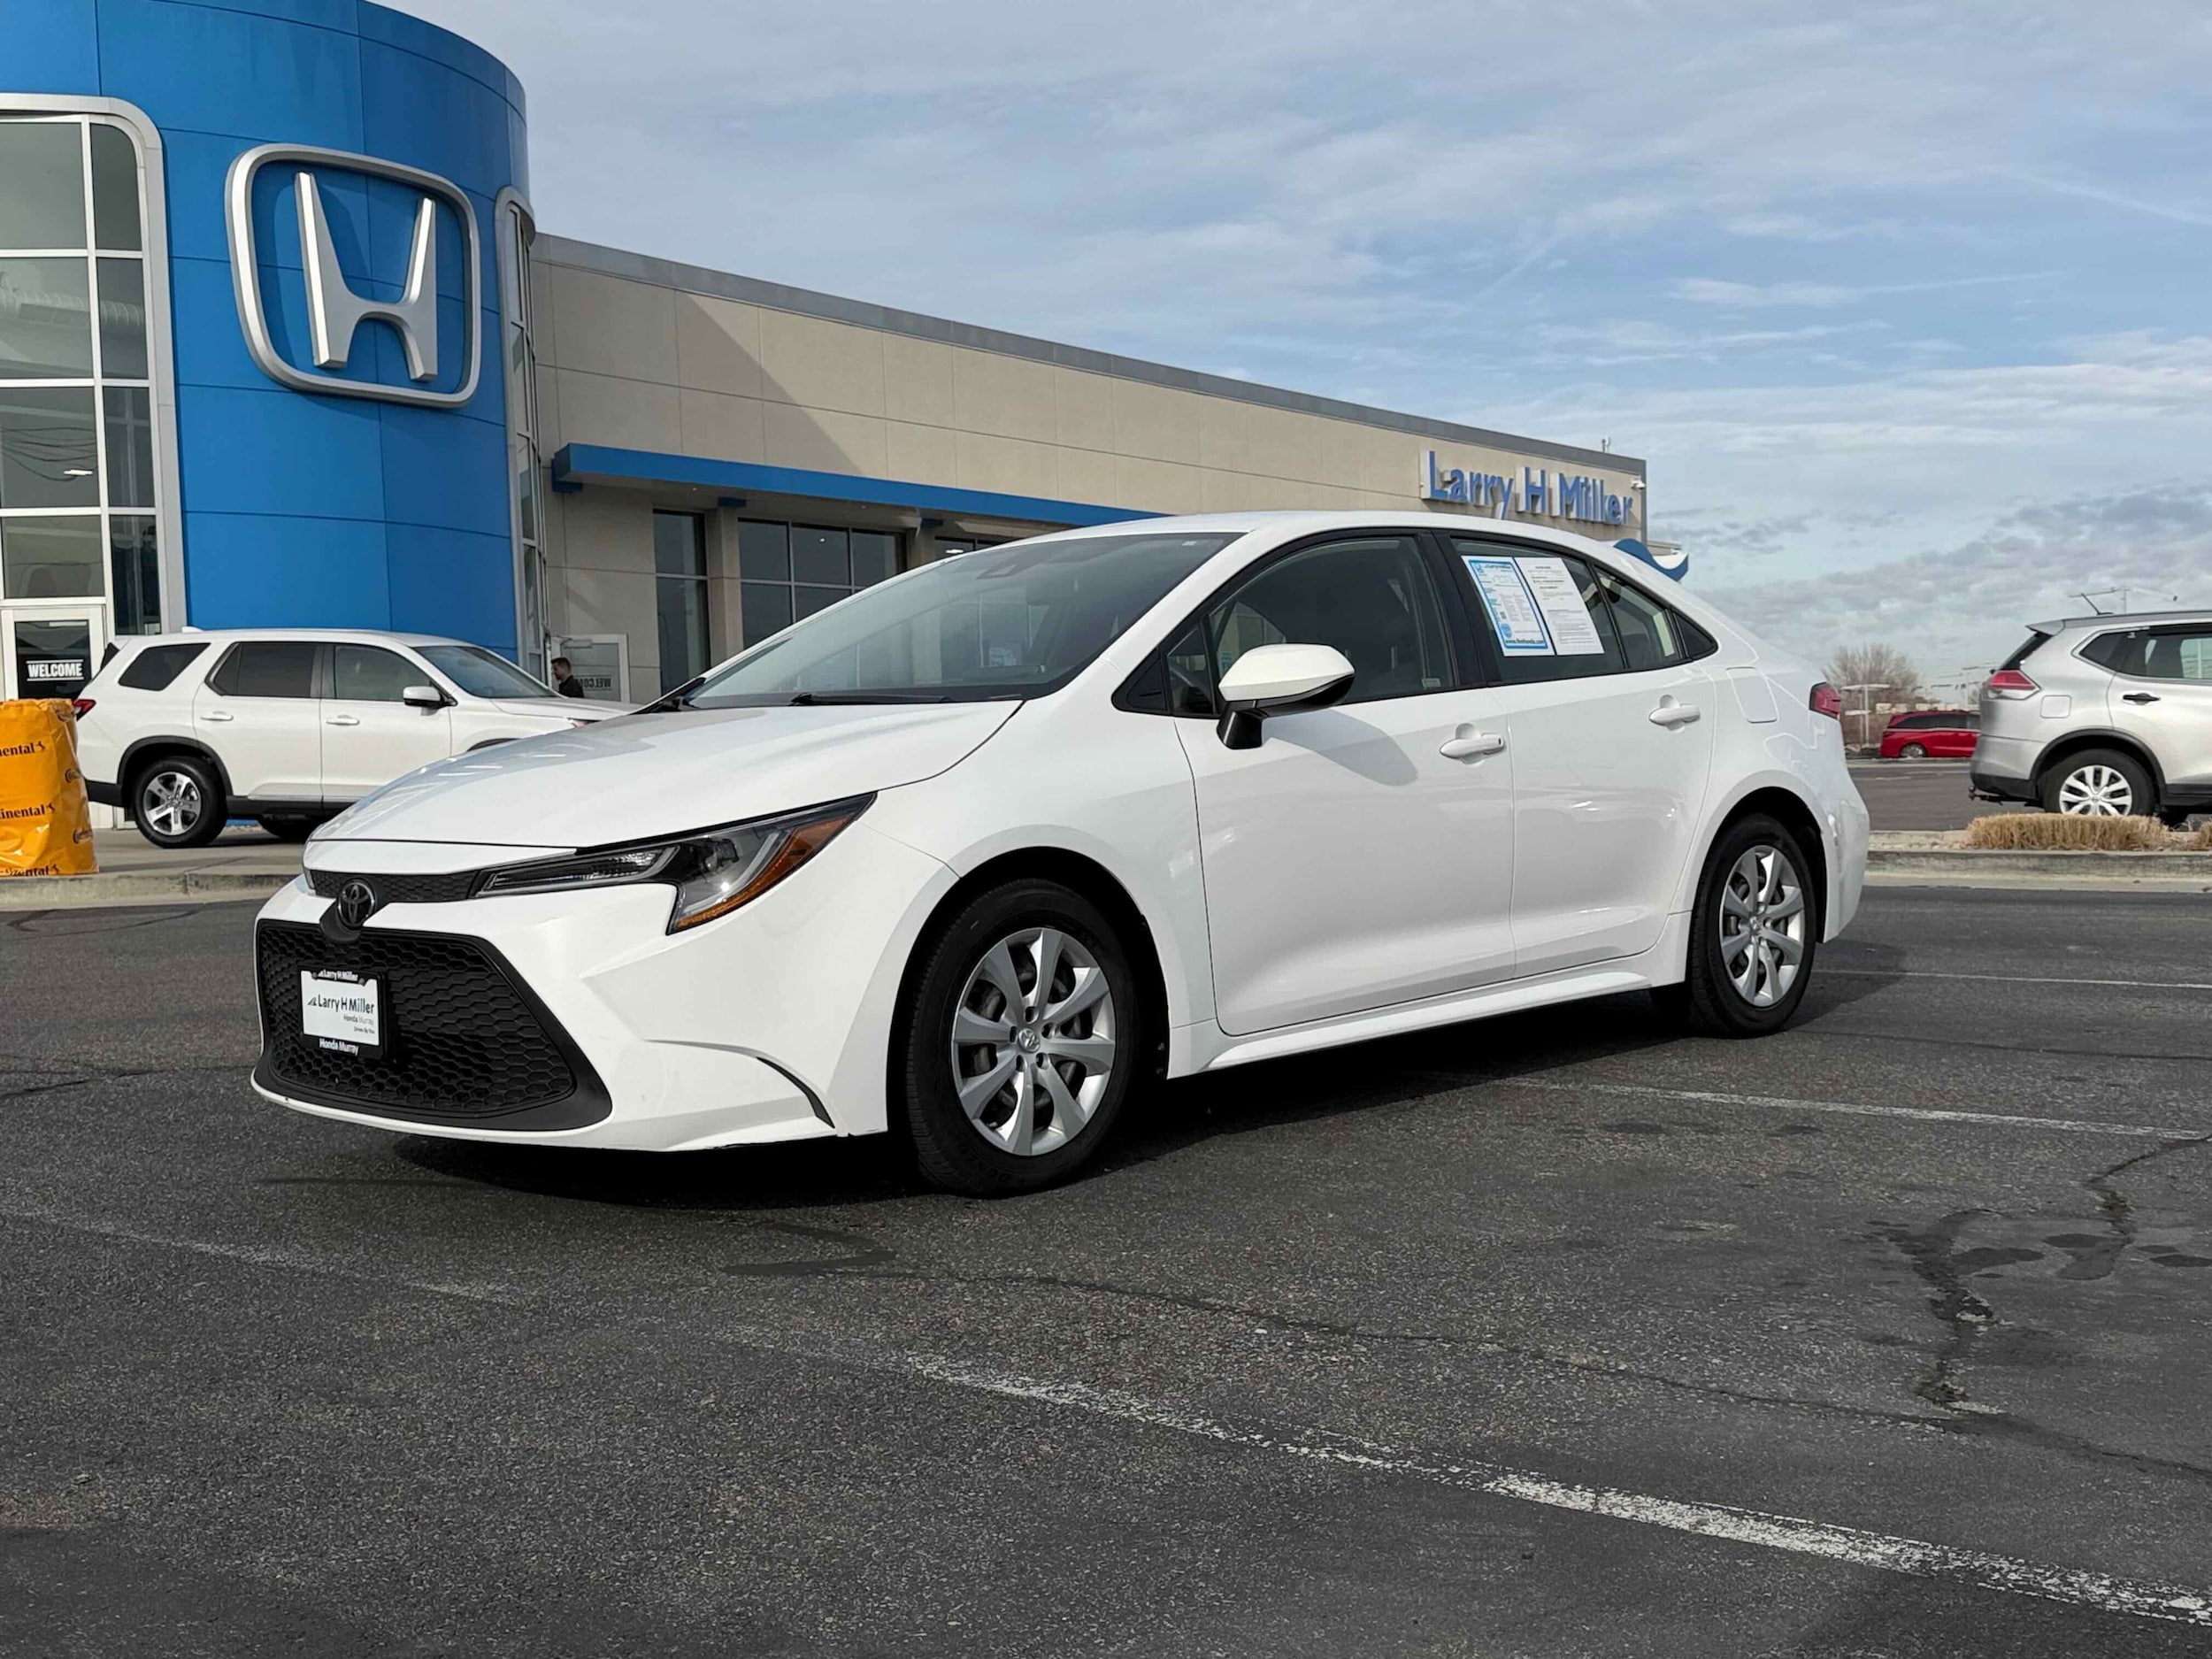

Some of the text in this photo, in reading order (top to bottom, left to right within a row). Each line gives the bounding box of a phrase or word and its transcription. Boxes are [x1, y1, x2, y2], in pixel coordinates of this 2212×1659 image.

[1421, 450, 1633, 525] Larry H Miller
[27, 663, 83, 678] WELCOME
[0, 804, 45, 818] inental
[318, 994, 374, 1014] Larry H Miller
